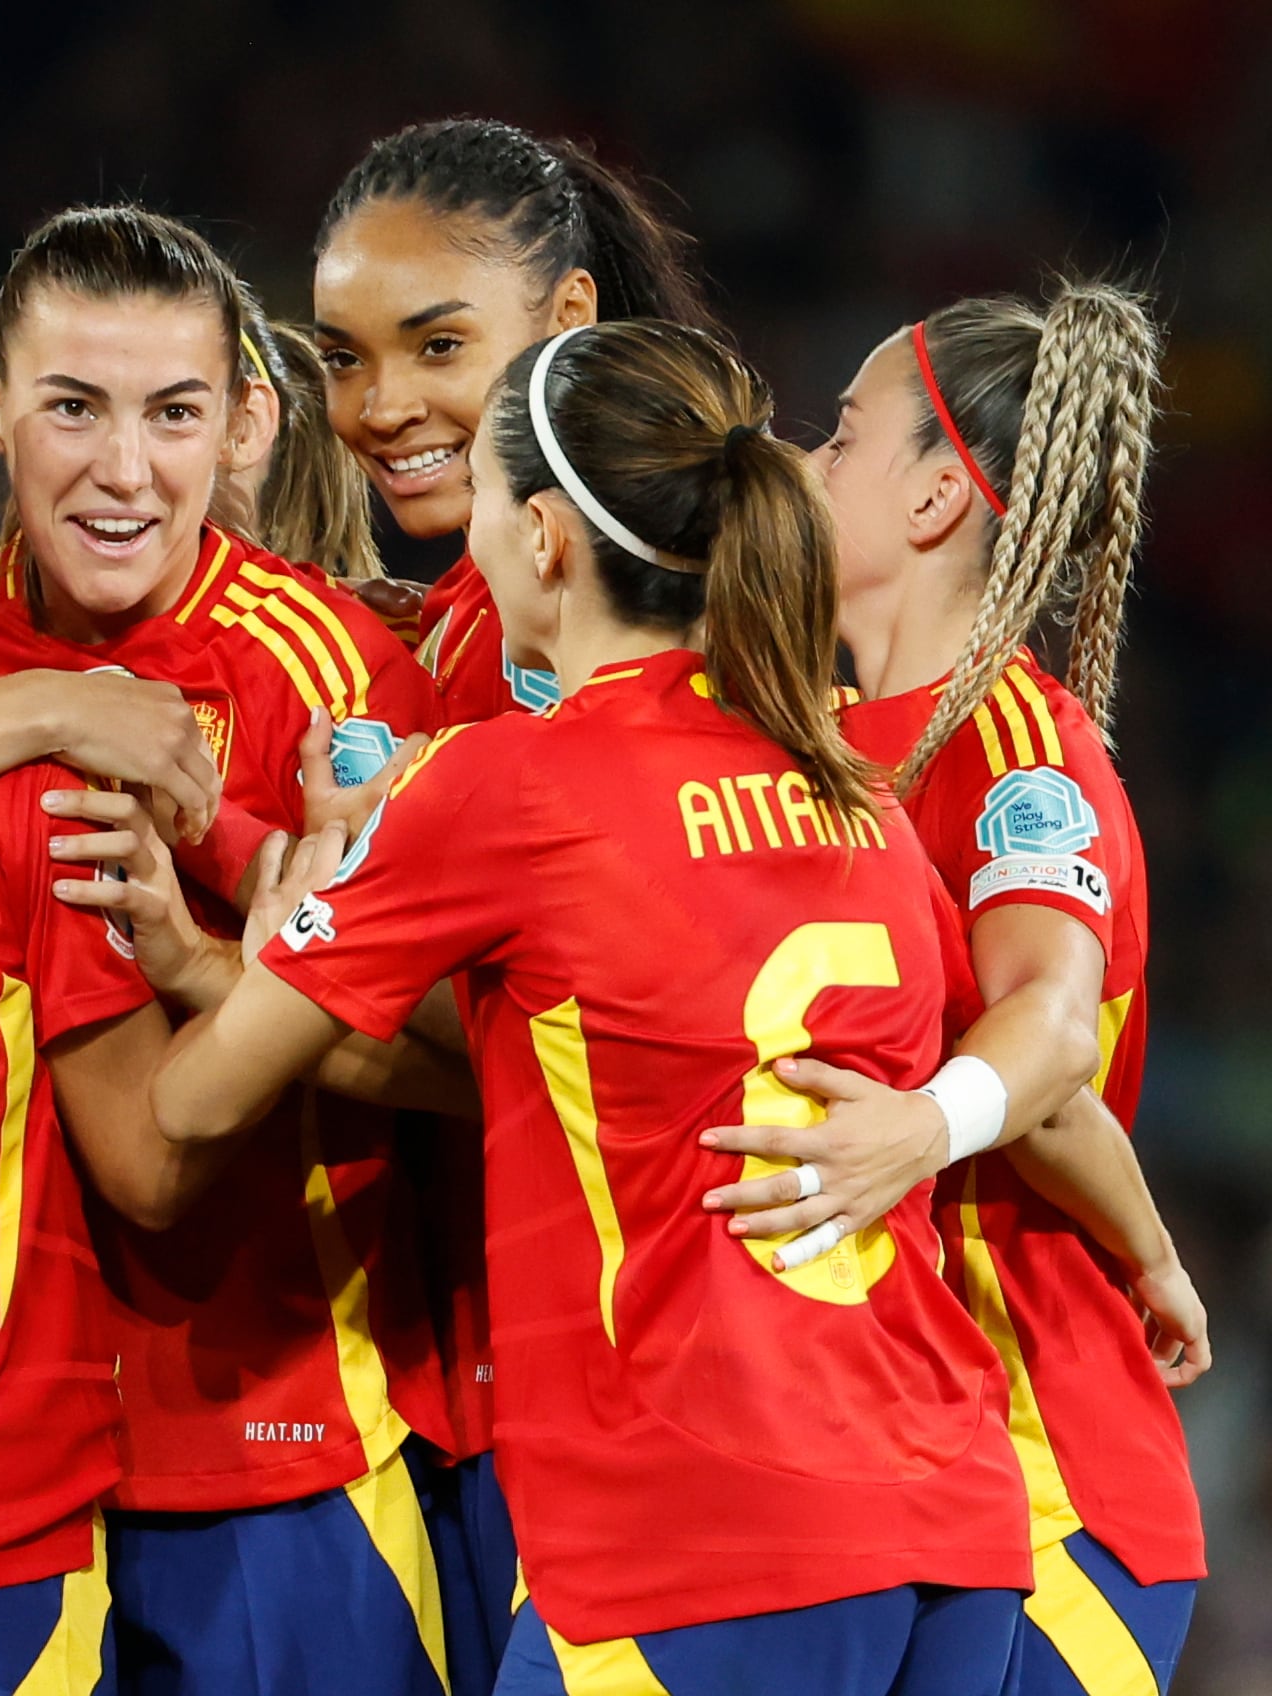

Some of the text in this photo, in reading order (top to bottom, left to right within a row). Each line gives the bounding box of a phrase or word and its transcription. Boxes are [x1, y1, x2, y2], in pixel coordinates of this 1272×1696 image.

[1011, 802, 1032, 811] We
[1014, 811, 1043, 824] Play
[1015, 820, 1062, 834] Strong
[734, 922, 901, 1306] 6
[245, 1421, 325, 1442] HEAT.RDY
